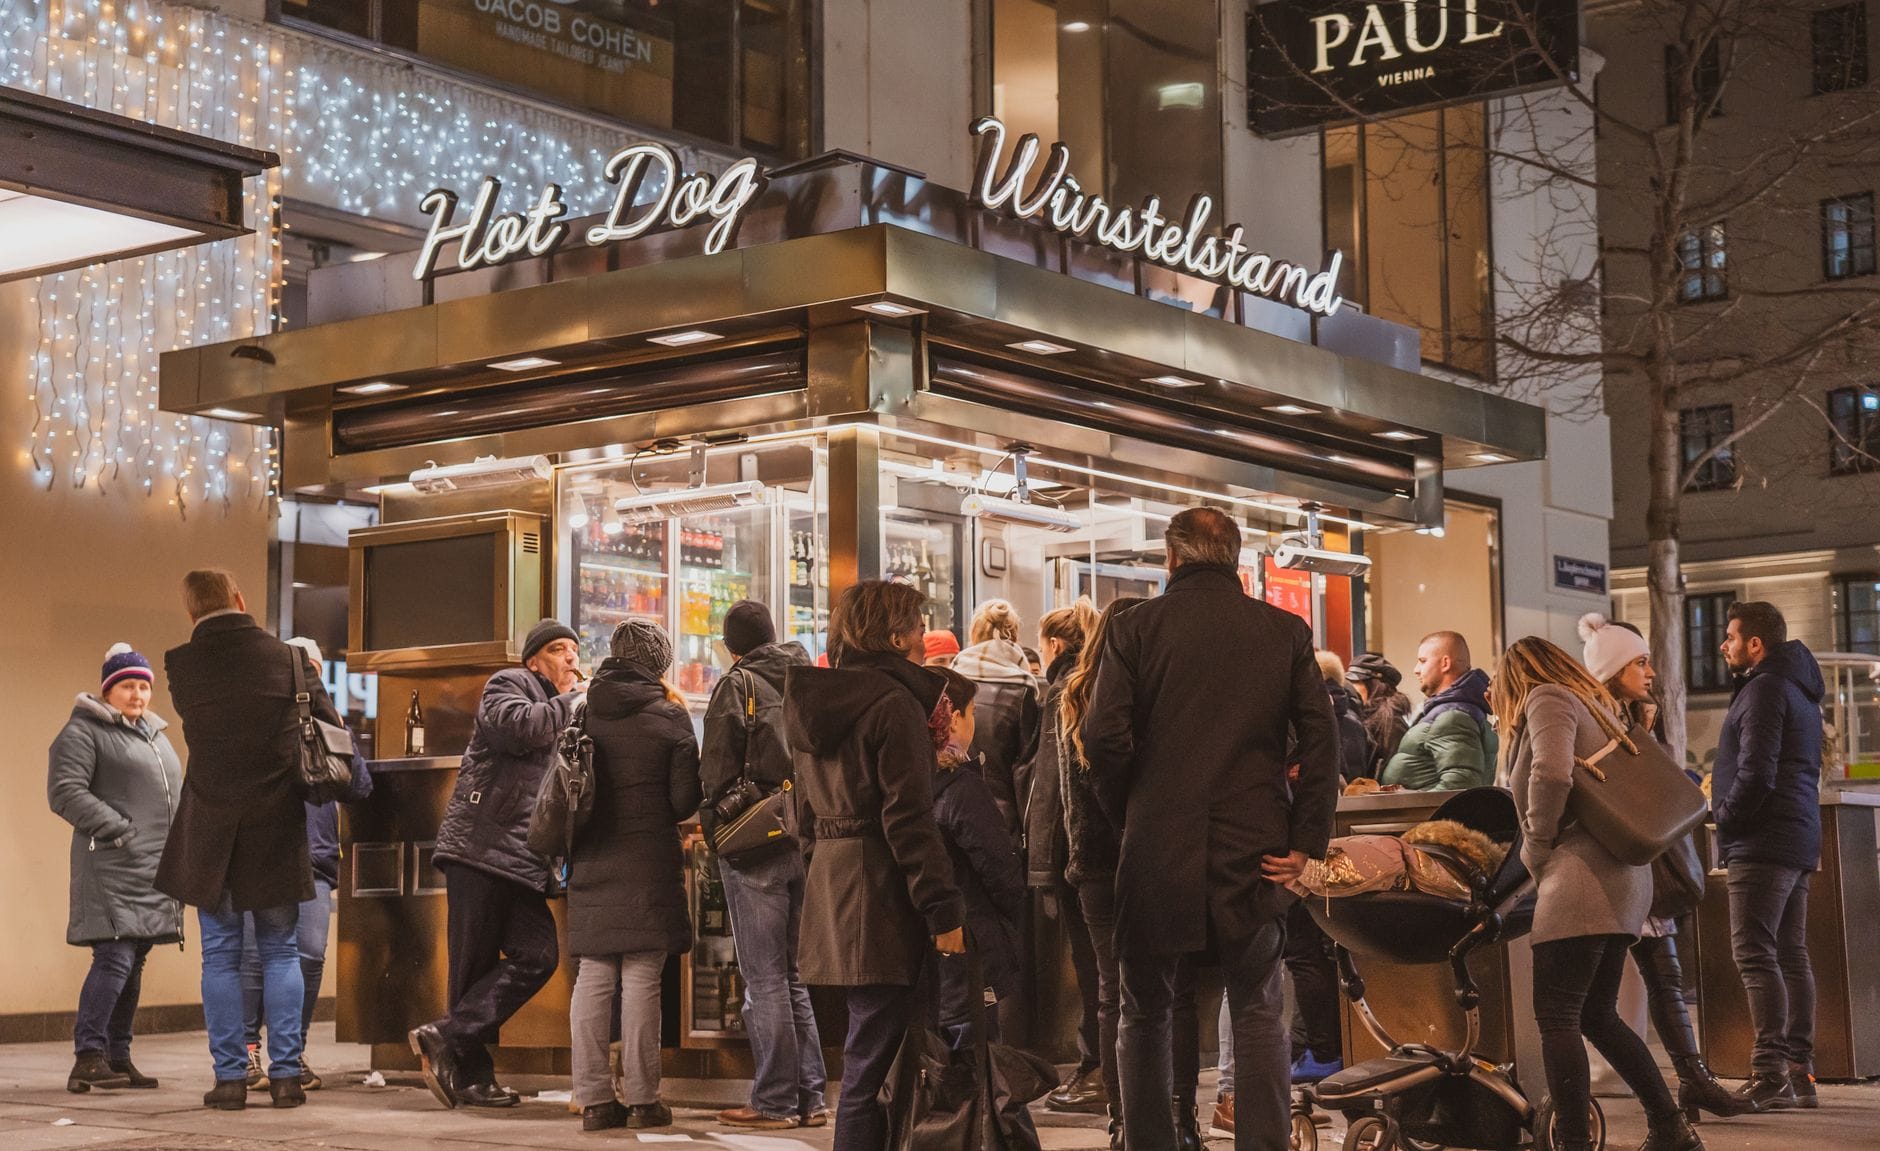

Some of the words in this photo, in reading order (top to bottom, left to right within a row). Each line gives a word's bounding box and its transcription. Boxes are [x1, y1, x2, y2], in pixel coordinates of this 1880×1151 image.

[474, 0, 561, 33] JACOB
[570, 17, 652, 63] COHËN
[1309, 0, 1504, 73] PAUL
[1378, 65, 1436, 87] VIENNA
[412, 175, 568, 281] Hot
[586, 141, 760, 256] Dog
[970, 115, 1343, 317] Würstelstand
